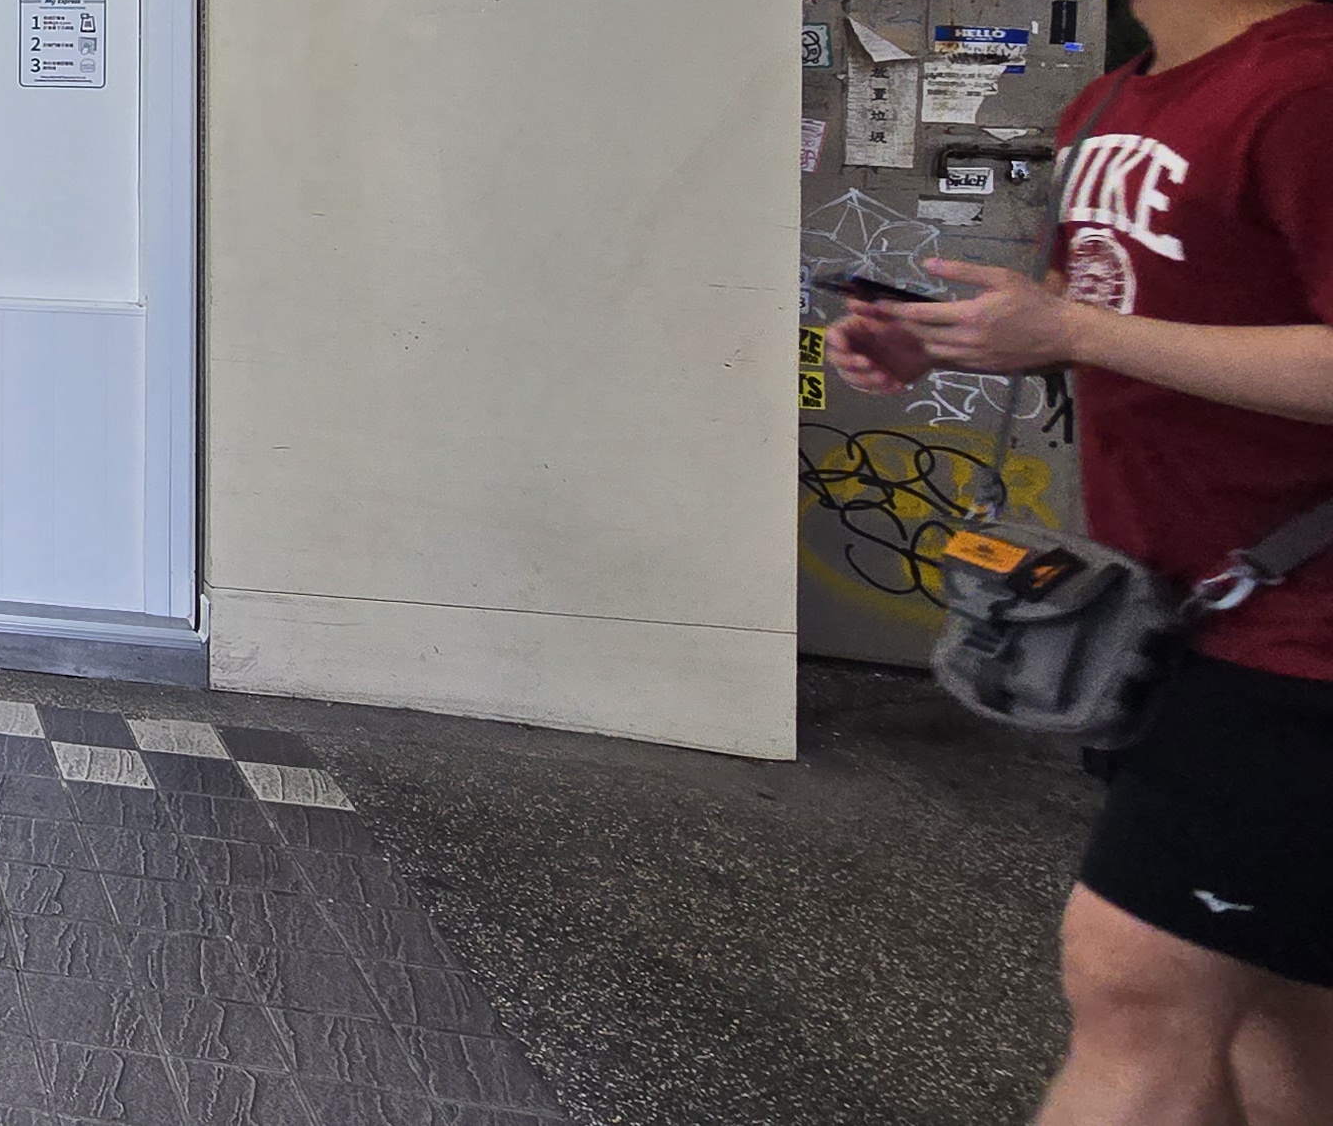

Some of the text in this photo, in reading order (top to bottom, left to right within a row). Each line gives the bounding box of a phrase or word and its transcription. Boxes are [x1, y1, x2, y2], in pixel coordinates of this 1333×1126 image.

[32, 16, 41, 30] 1
[955, 29, 1006, 38] HELLO
[31, 37, 41, 51] 2
[31, 58, 41, 72] 3
[1054, 134, 1190, 262] NIKE
